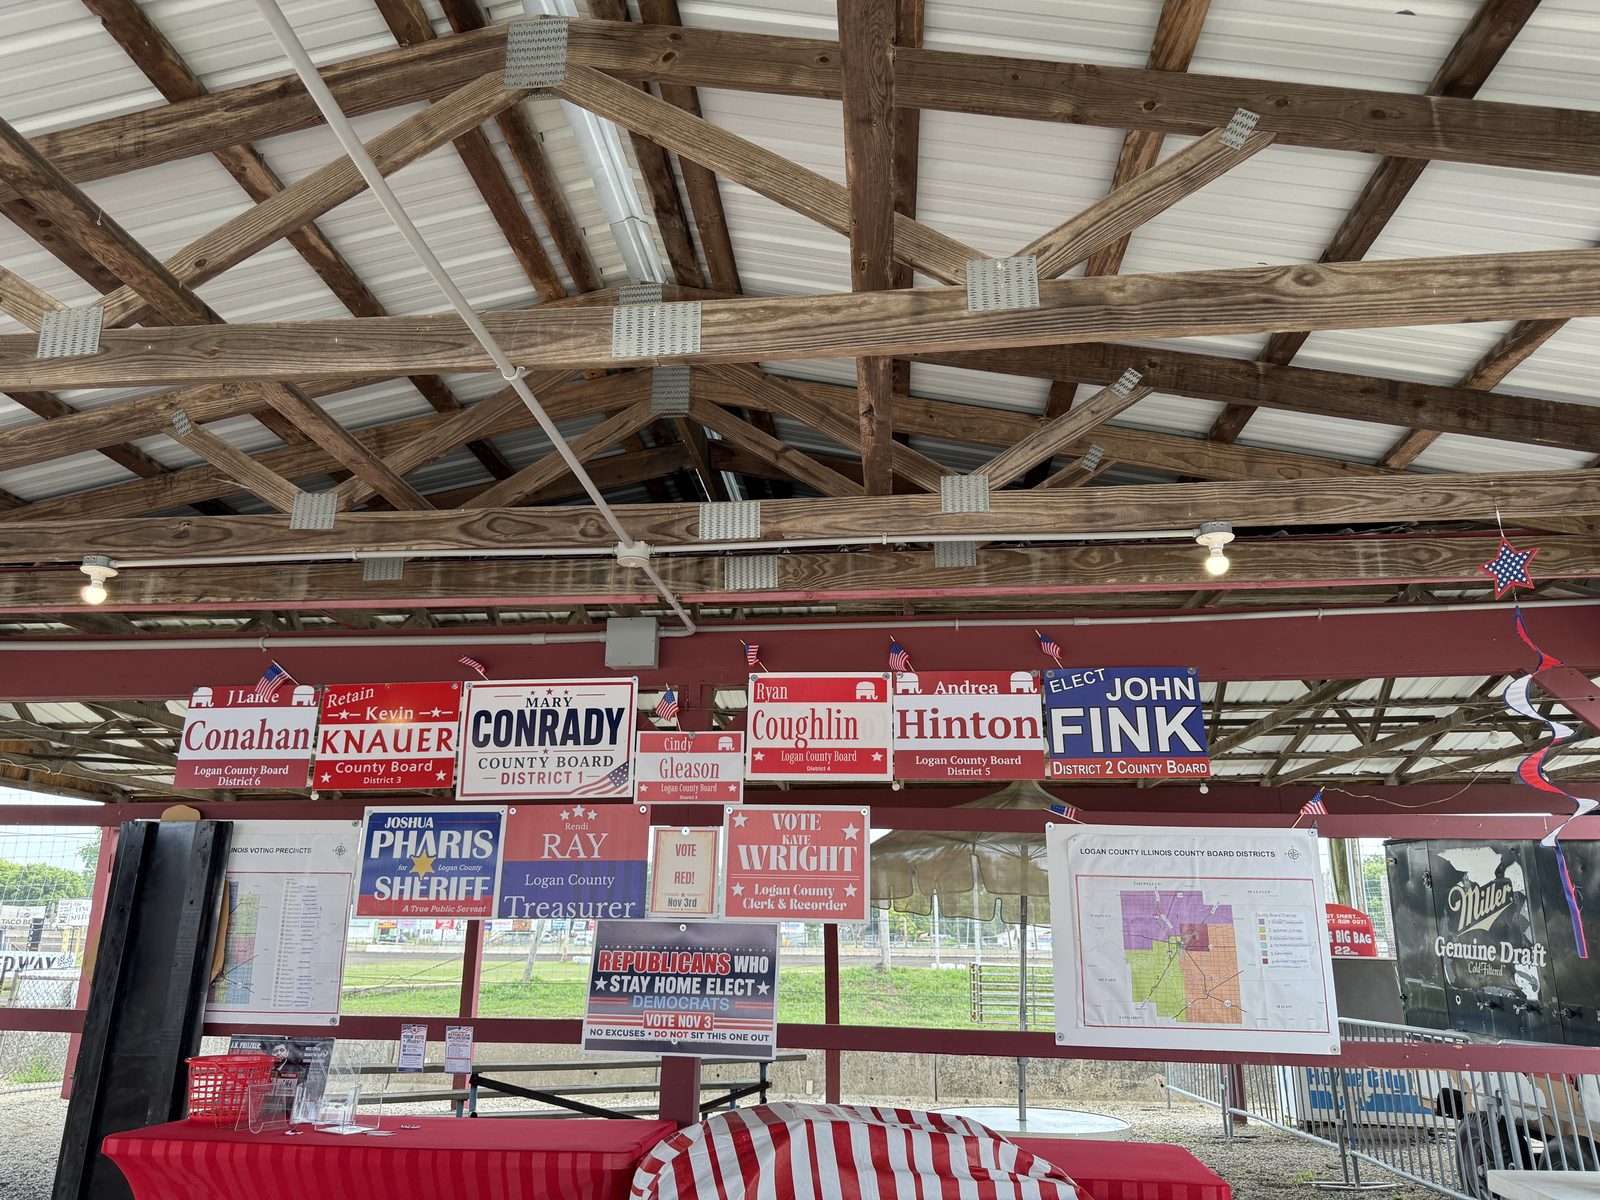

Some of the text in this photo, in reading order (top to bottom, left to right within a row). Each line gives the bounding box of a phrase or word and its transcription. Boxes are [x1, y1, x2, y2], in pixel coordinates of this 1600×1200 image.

[934, 680, 999, 695] Andrea
[1050, 668, 1105, 694] ELECT
[1105, 677, 1196, 701] JOHN
[226, 690, 235, 706] J
[326, 686, 374, 708] Retain
[756, 682, 788, 702] Ryan
[526, 696, 574, 708] MARY
[366, 706, 414, 720] Kevin
[472, 708, 626, 748] CONRADY
[752, 708, 859, 748] Coughlin
[896, 708, 1040, 740] Hinton
[1050, 706, 1204, 754] FINK
[184, 718, 310, 752] Conahan
[320, 728, 454, 754] KNAUER
[664, 737, 693, 754] Cindy
[478, 756, 614, 770] COUNTY BOARD
[781, 750, 857, 764] Logan County Board
[916, 756, 1022, 767] Logan County Board
[194, 765, 289, 776] Logan County Board
[336, 760, 433, 776] County Board
[660, 756, 720, 779] Gleason
[948, 768, 991, 776] District 5
[1053, 760, 1207, 775] DISTRICT 2 COUNTY BOARD
[218, 776, 261, 786] District 6
[364, 776, 402, 784] District 3
[501, 771, 584, 785] DISTRICT 1
[661, 783, 717, 794] Logan County Board
[384, 816, 434, 828] JOSHUA
[772, 813, 822, 831] VOTE
[370, 830, 494, 859] PHARIS
[540, 833, 608, 858] RAY
[782, 834, 811, 845] KATE
[675, 844, 696, 857] VOTE
[738, 844, 858, 872] WRIGHT
[525, 874, 615, 888] Logan County
[674, 871, 695, 884] RED!
[374, 876, 490, 901] SHERIFF
[754, 883, 836, 899] Logan County
[504, 896, 636, 918] Treasurer
[668, 898, 697, 908] Nov 3rd
[742, 898, 847, 911] Clerk & Recorder
[1448, 882, 1512, 932] Miller
[1336, 930, 1351, 943] BIG
[1353, 931, 1372, 944] BAG
[1334, 946, 1351, 955] 22
[1434, 936, 1546, 968] Genuine Draft
[598, 950, 769, 975] REPUBLICANS WHO
[610, 975, 755, 996] STAY HOME ELECT
[632, 995, 730, 1011] DEMOCRATS
[646, 1014, 712, 1028] VOTE NOV 3
[606, 1030, 645, 1038] EXCUSES
